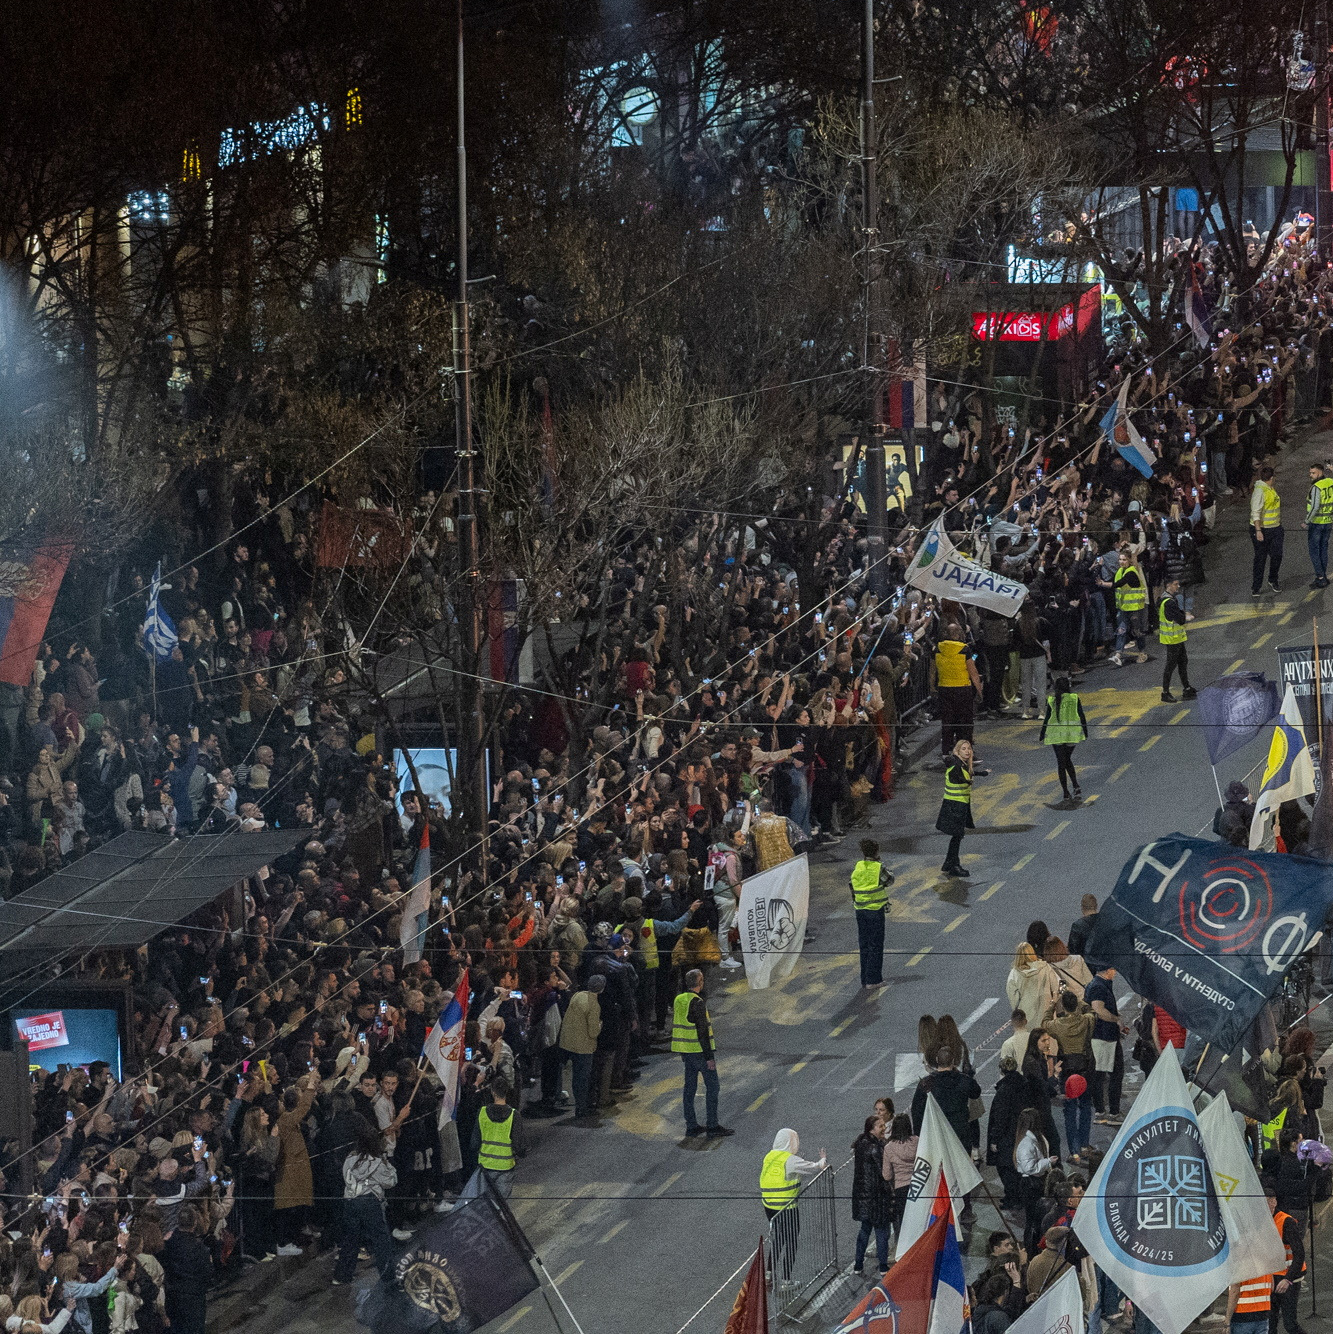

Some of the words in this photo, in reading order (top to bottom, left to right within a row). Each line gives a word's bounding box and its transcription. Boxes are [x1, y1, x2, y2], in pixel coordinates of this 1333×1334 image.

[747, 908, 757, 953] KOLUBARA
[22, 1023, 50, 1036] VREDNO
[52, 1021, 61, 1031] JE
[1124, 1120, 1179, 1160] ФАКУЛТЕТ
[1109, 1202, 1130, 1245] БЛОКАДА
[1131, 1241, 1174, 1261] 2024/25
